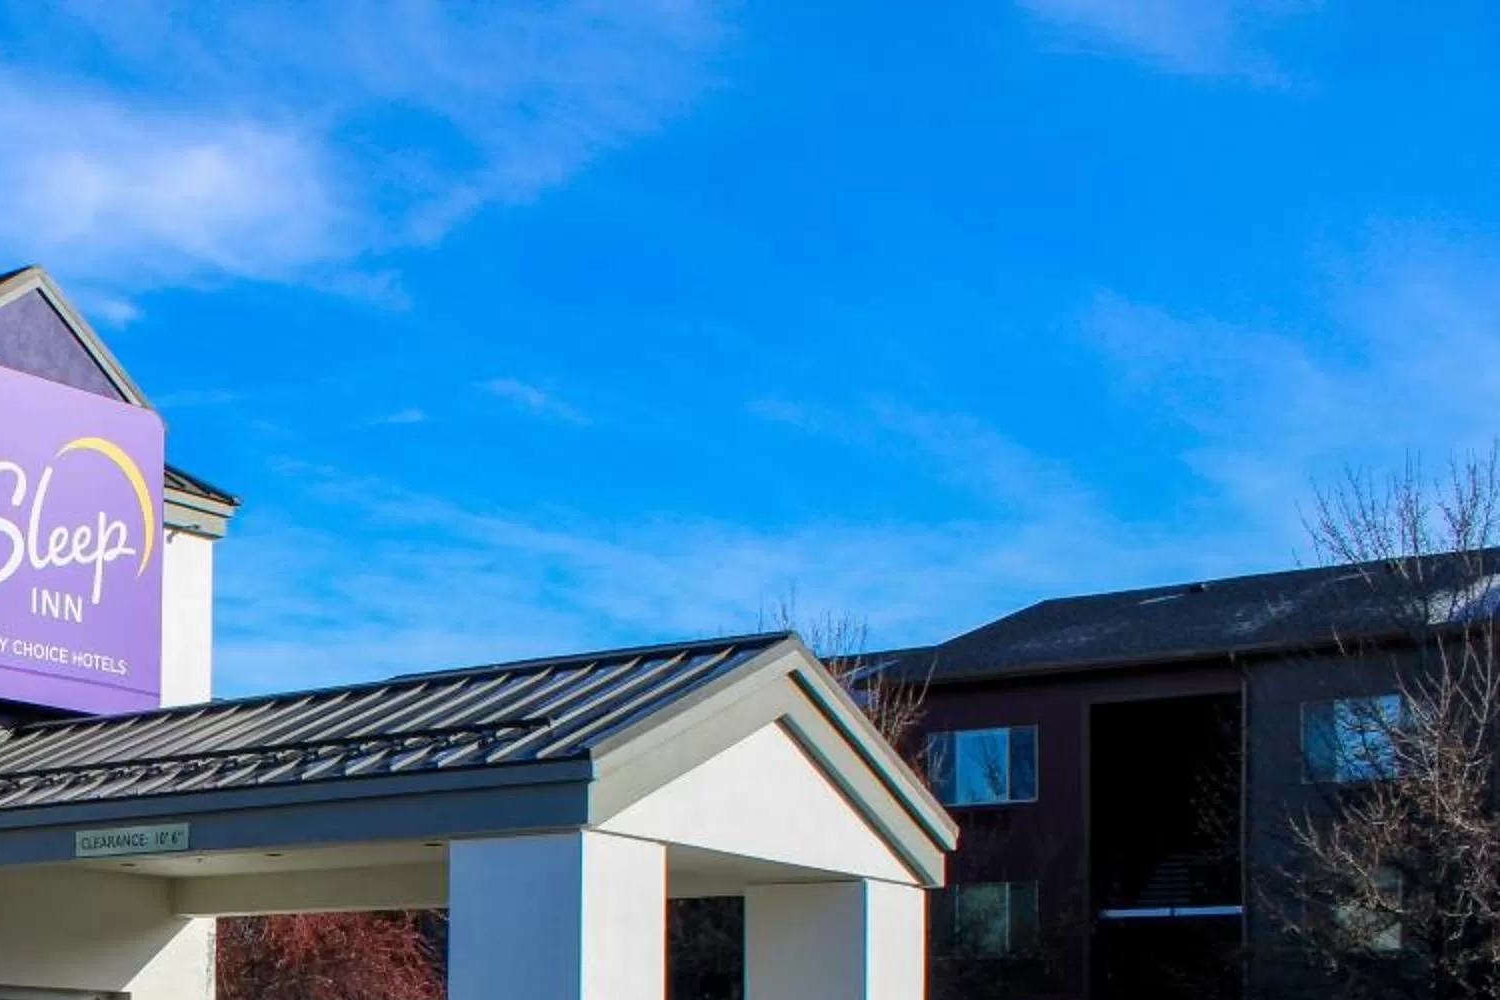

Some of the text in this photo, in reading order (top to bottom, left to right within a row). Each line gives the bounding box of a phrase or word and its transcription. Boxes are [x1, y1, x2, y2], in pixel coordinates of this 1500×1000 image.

[31, 587, 83, 623] INN
[13, 639, 69, 664] CHOICE
[72, 651, 128, 675] HOTELS
